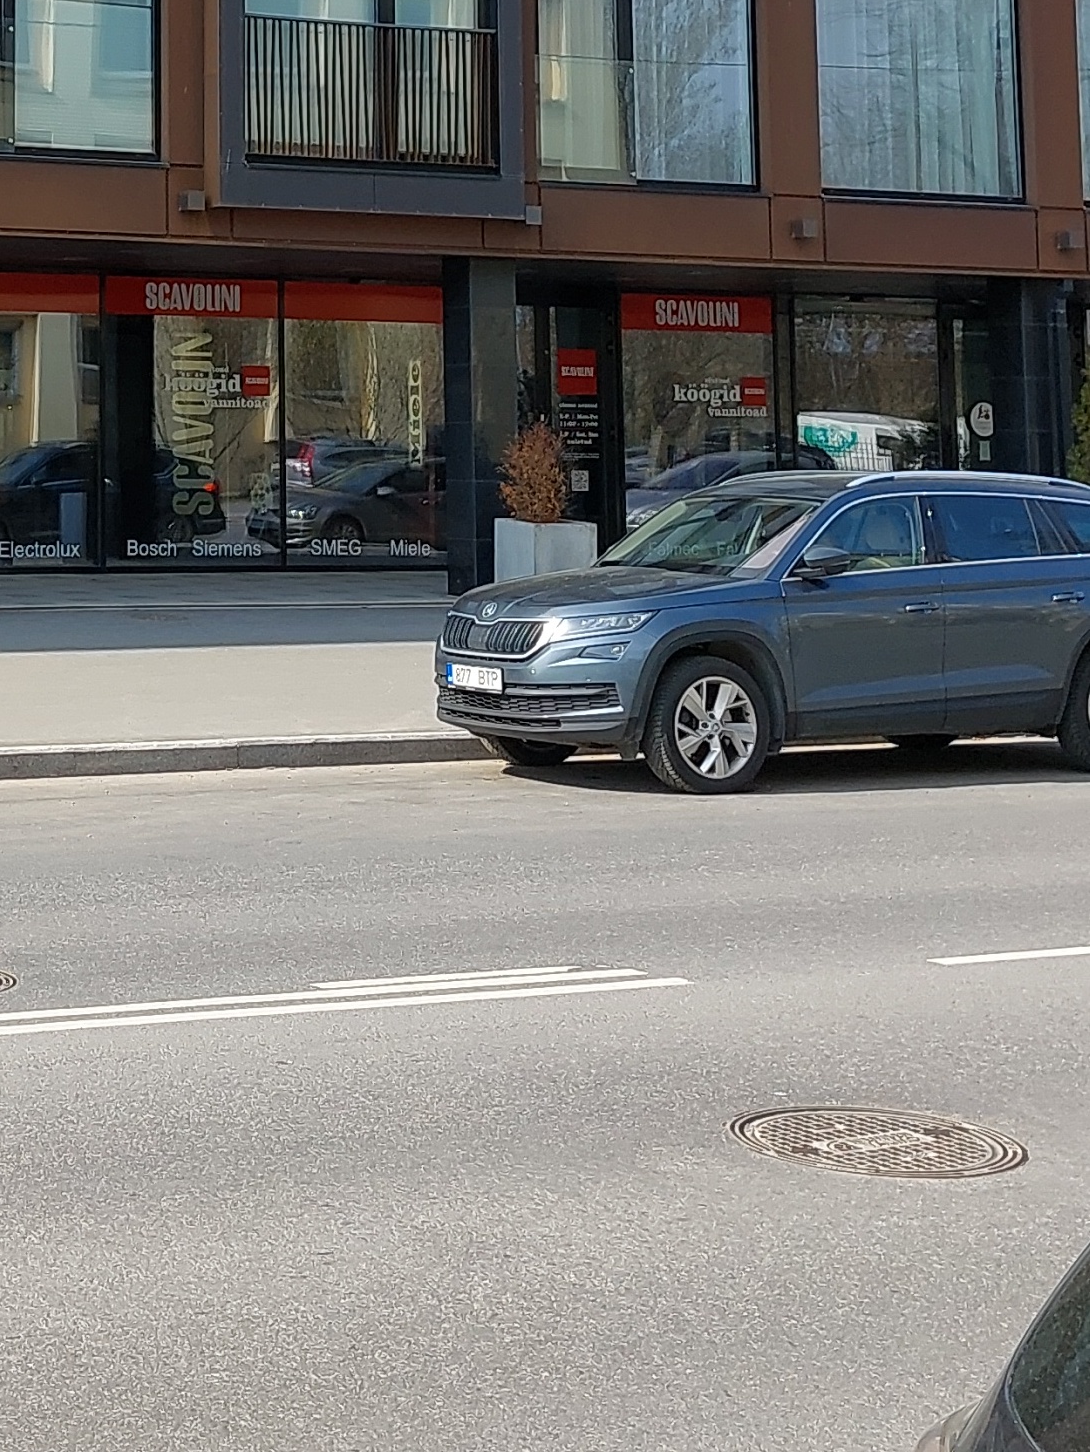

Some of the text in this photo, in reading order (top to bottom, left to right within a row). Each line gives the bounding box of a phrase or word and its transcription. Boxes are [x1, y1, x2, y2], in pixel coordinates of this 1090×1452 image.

[145, 282, 241, 312] SCAVOLINI
[655, 299, 740, 328] SCAVOLINI
[673, 383, 742, 408] köögid
[707, 405, 768, 418] vannitoad
[127, 539, 262, 558] Bosch Siemens
[310, 538, 432, 558] SMEG Miele
[455, 667, 499, 687] 877 BTP
